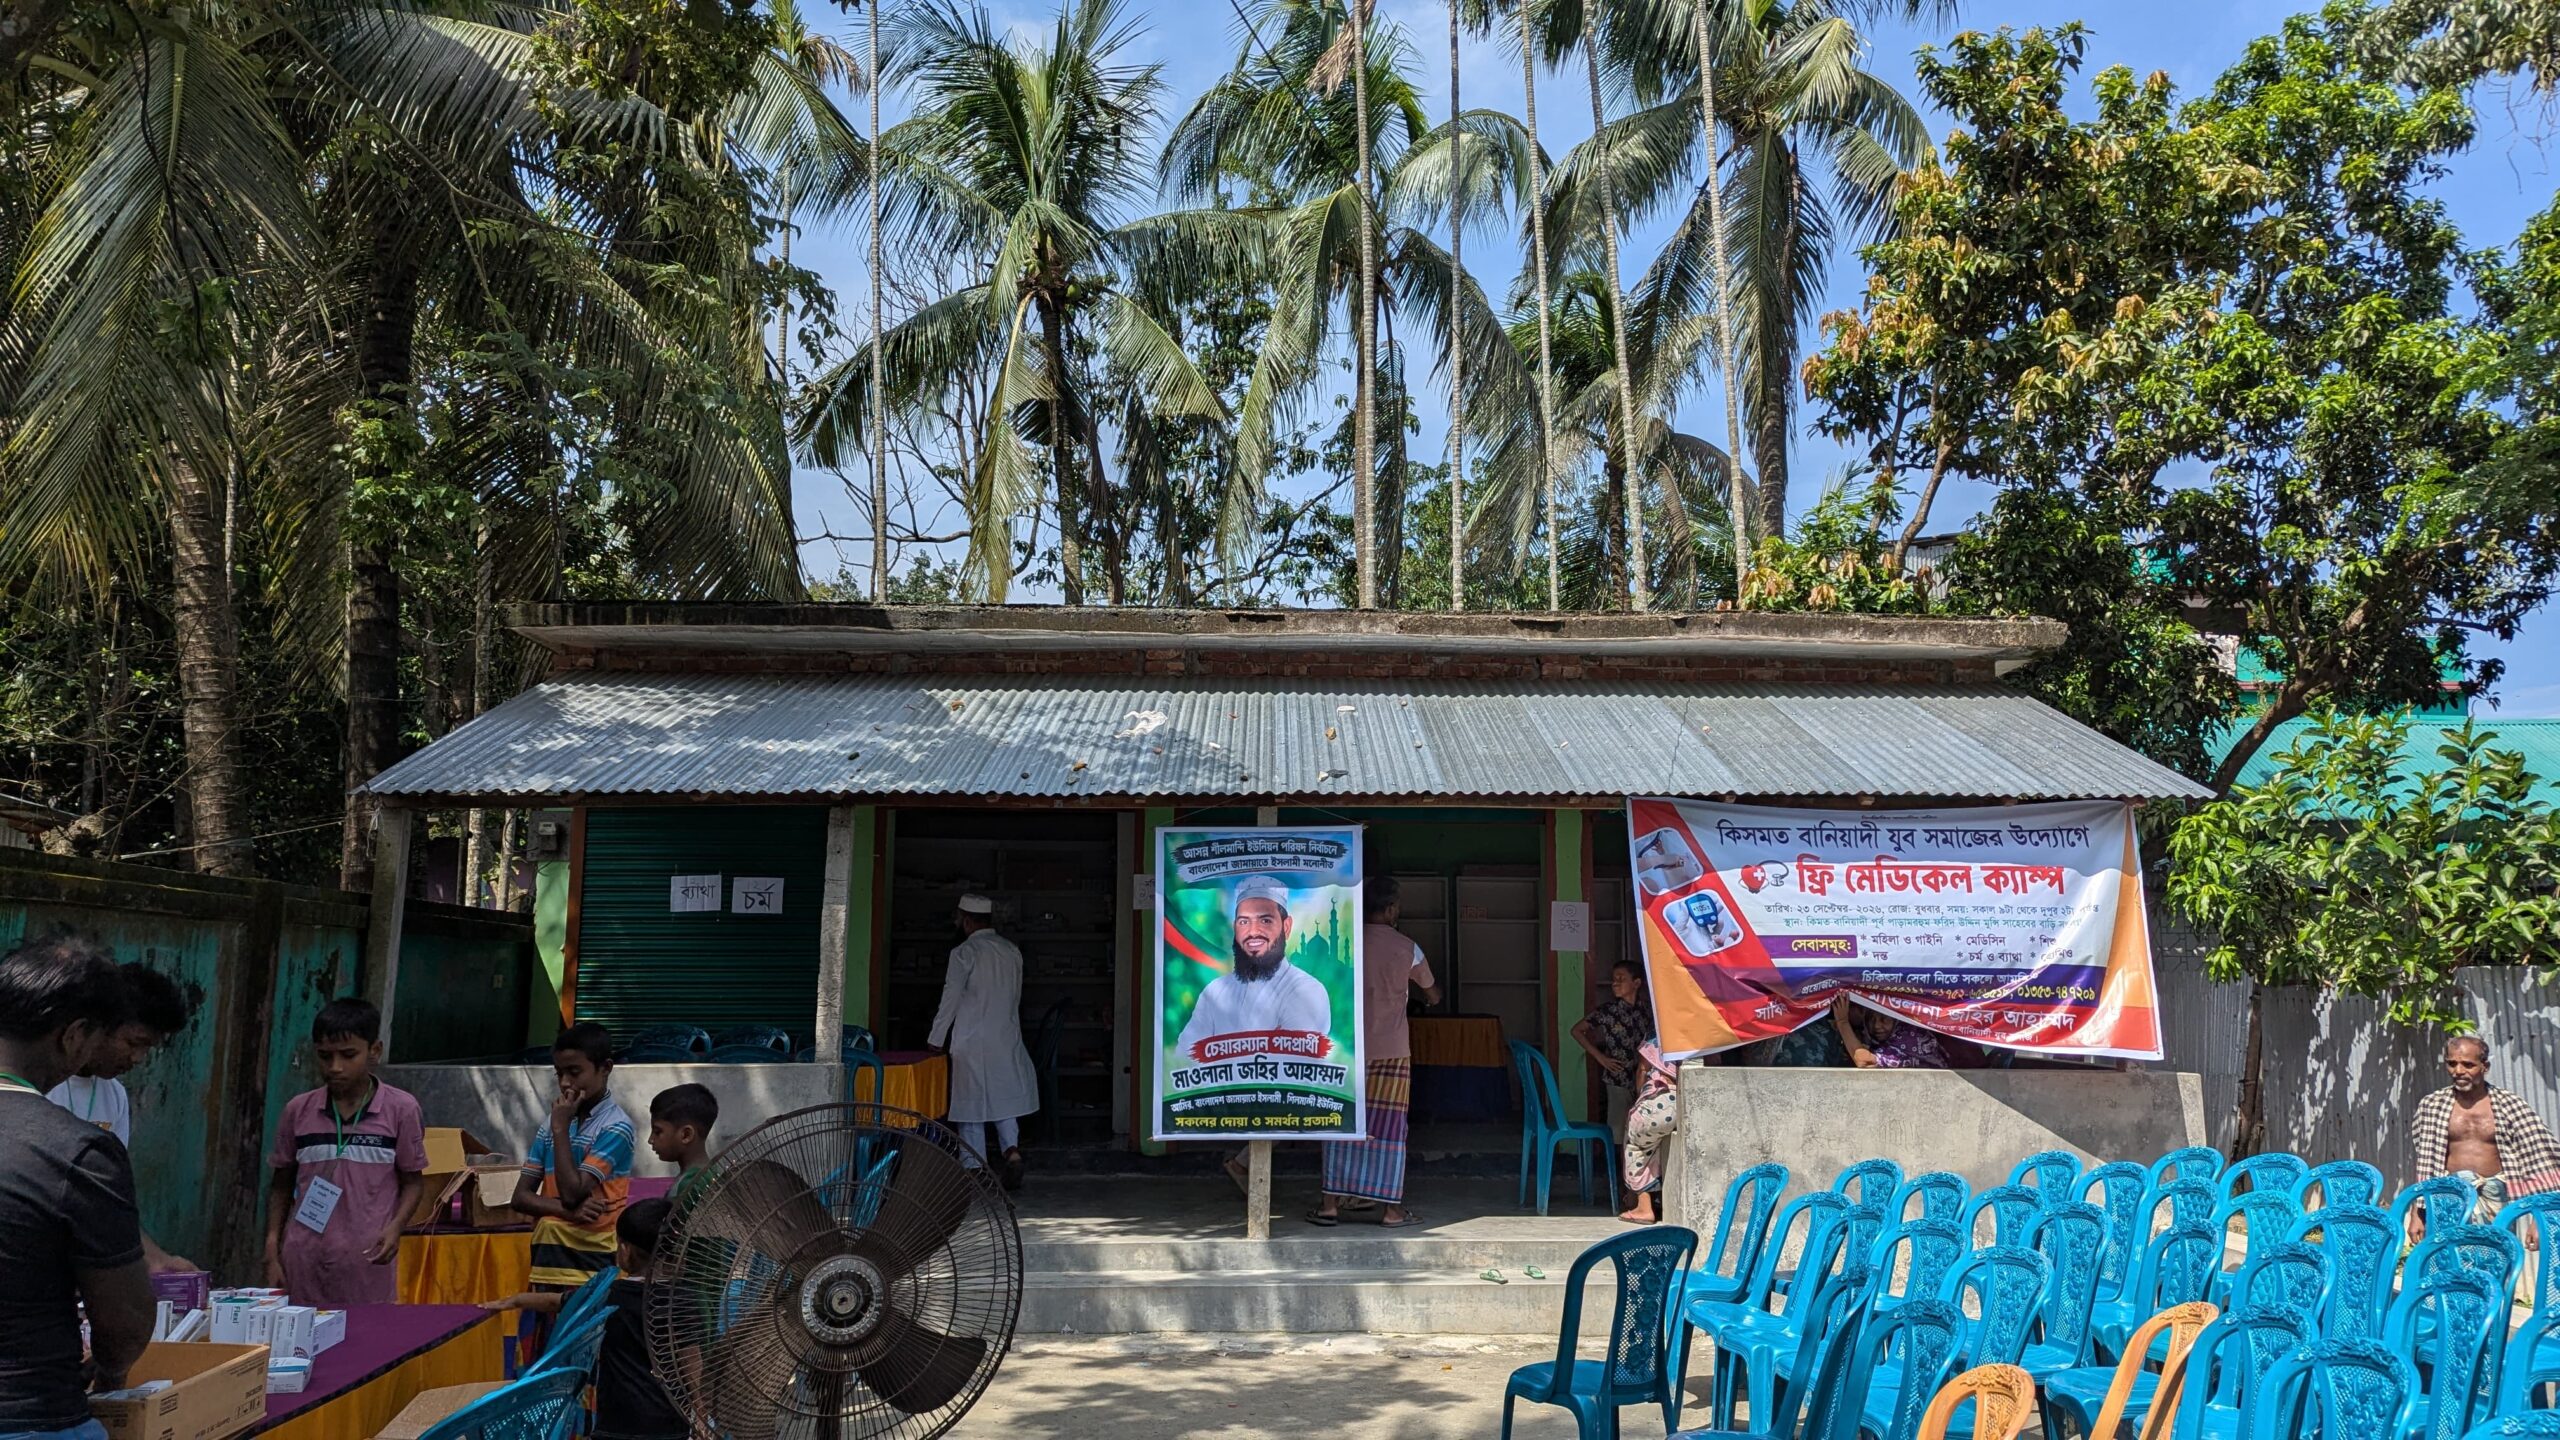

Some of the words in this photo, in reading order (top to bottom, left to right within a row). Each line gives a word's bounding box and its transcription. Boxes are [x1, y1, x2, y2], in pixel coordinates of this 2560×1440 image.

[1716, 819, 1791, 846] কিসমত
[1797, 820, 1881, 848] বানিয়াদী
[1886, 828, 1917, 853] যুব
[1922, 826, 2003, 848] সমাজের
[2007, 822, 2090, 848] উদ্যোগে
[1183, 846, 1209, 859] আসন্ন
[1247, 839, 1278, 853] ইউনিয়ন
[1280, 840, 1307, 853] পরিষদ
[1308, 840, 1338, 856] নির্বাচনে
[1188, 860, 1228, 875] বাংলাদেশ
[1231, 857, 1269, 870] জামায়াতে
[1270, 855, 1300, 867] ইসলামী
[1303, 857, 1334, 870] মনোনীত
[1795, 853, 1834, 896] ফ্রি
[1845, 854, 1972, 894] মেডিকেল
[1980, 864, 2064, 895] ক্যাম্প
[680, 883, 716, 899] ব্যাথা
[742, 883, 776, 910] চর্ম
[1764, 902, 1793, 914] তারিখ:
[1797, 904, 1810, 914] ২৩
[1888, 903, 1911, 914] রোজ:
[1947, 904, 1969, 914] সময়:
[1972, 904, 1996, 914] সকাল
[2016, 905, 2038, 915] থেকে
[2040, 905, 2059, 917] দুপুর
[1871, 916, 1884, 928] পূর্ব
[1933, 917, 1955, 927] ফরিদ
[1958, 917, 1981, 928] উদ্দিন
[2002, 918, 2037, 928] সাহেবের
[2039, 918, 2056, 931] বাড়ি
[1791, 937, 1852, 955] সেবাসমূহ:
[1871, 932, 1899, 946] মহিলা
[1904, 936, 1912, 945] ও
[1915, 932, 1943, 947] গাইনি
[1966, 933, 2006, 947] মেডিসিন
[1873, 951, 1889, 962] দন্ত
[1968, 949, 1983, 962] চর্ম
[1987, 951, 1995, 961] ও
[1862, 970, 1901, 983] চিকিৎসা
[1906, 972, 1930, 984] সেবা
[1934, 970, 1958, 984] নিতে
[1962, 973, 1993, 985] সকলে
[1204, 1036, 1269, 1058] চেয়ারম্যান
[1272, 1033, 1319, 1055] পদপ্রার্থী
[1172, 1063, 1233, 1089] মাওলানা
[1237, 1054, 1279, 1082] জহির
[1283, 1061, 1346, 1086] আহাম্মদ
[1195, 1096, 1225, 1108] বাংলাদেশ
[1257, 1090, 1281, 1104] ইসলামী
[1317, 1096, 1344, 1112] ইউনিয়ন
[1175, 1117, 1217, 1128] সকলের
[1220, 1117, 1248, 1128] দোয়া
[1252, 1117, 1261, 1127] ও
[1265, 1113, 1300, 1127] সমর্থন
[1303, 1112, 1342, 1127] প্রত্যাশী
